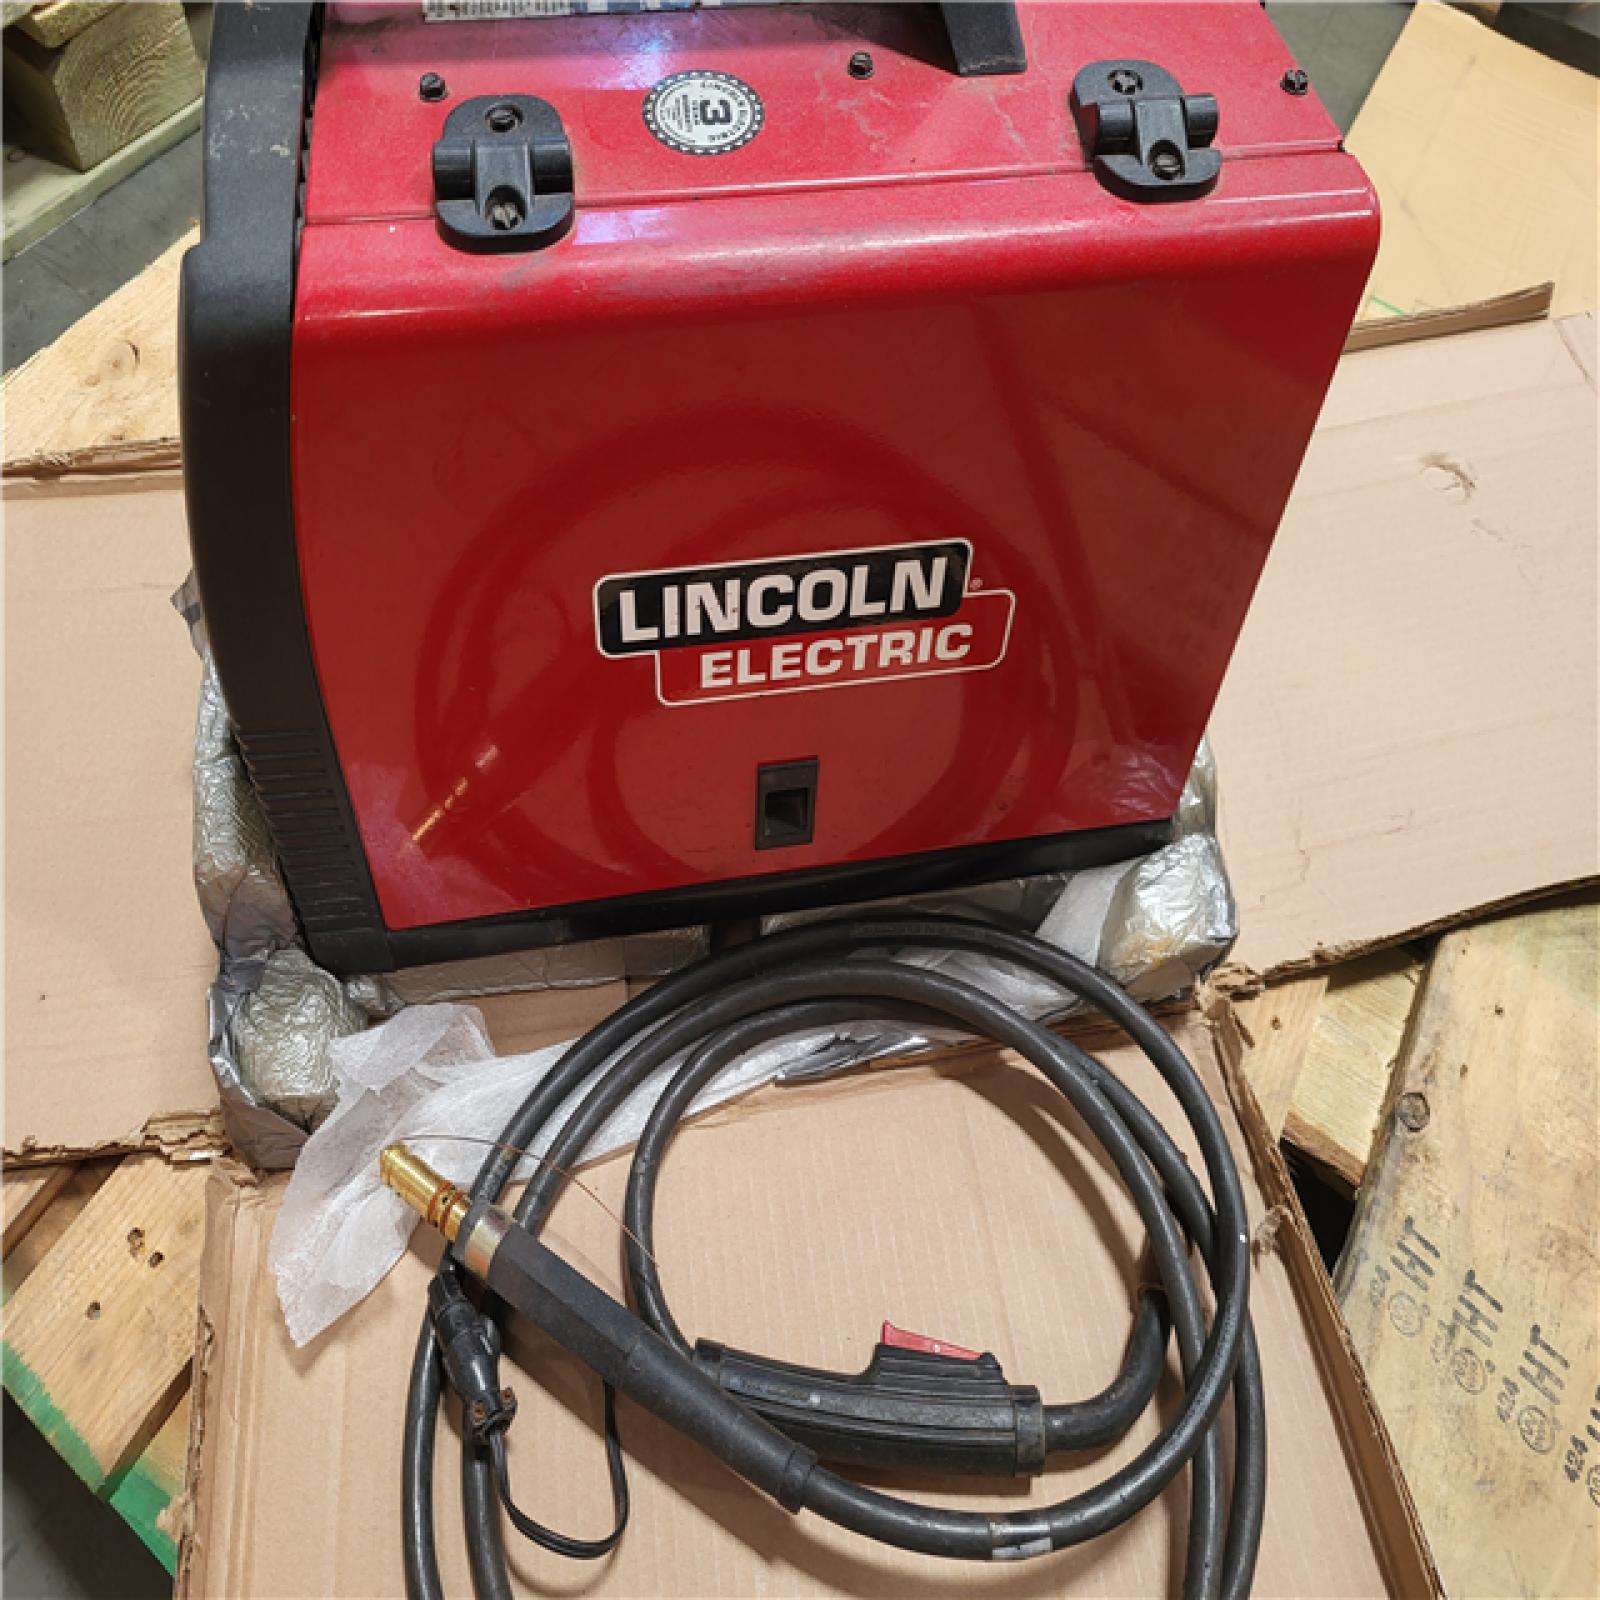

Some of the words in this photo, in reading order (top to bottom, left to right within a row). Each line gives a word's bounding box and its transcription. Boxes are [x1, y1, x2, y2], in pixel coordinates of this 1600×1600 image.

[700, 99, 731, 125] 3
[619, 557, 947, 643] LINCOLN
[701, 624, 973, 688] ELECTRIC
[1390, 1215, 1440, 1291] HT
[1453, 1269, 1503, 1347] HT
[1518, 1325, 1569, 1405] HT
[1564, 1434, 1588, 1482] 424
